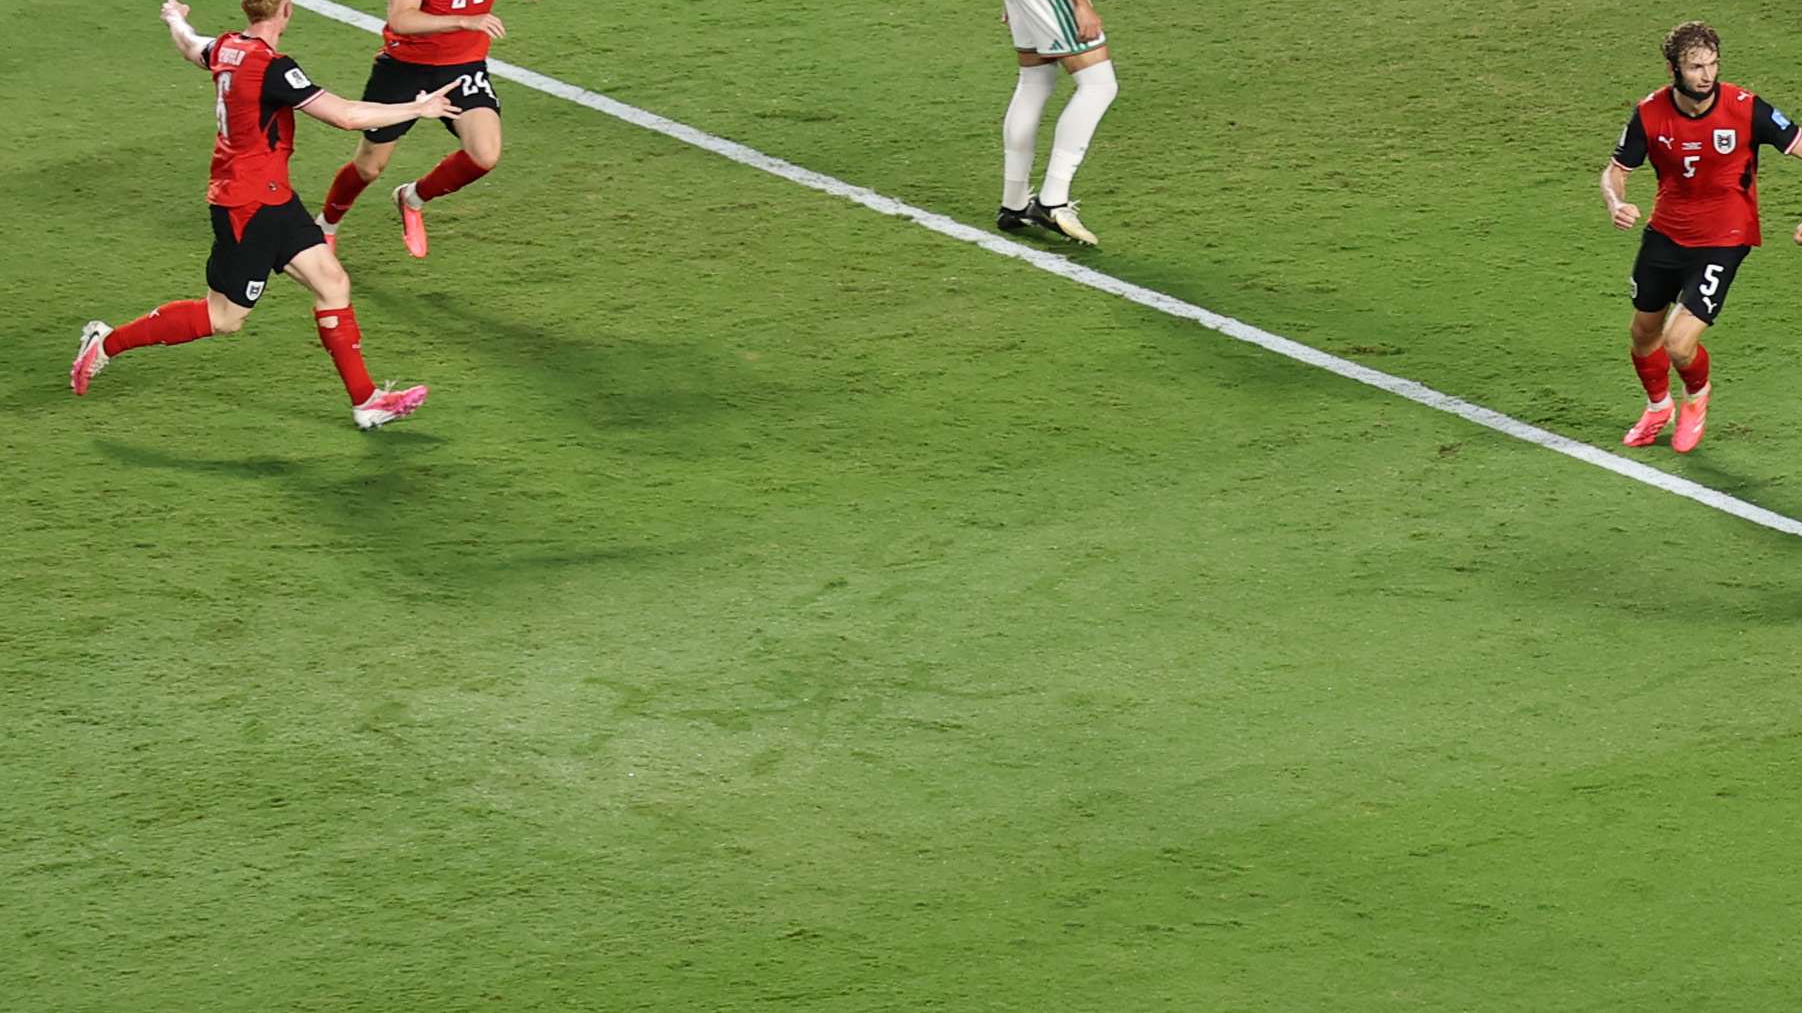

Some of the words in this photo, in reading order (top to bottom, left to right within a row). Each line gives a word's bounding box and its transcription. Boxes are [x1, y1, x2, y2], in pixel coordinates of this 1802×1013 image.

[459, 71, 496, 99] 24
[1682, 155, 1701, 178] 5
[1699, 264, 1724, 296] 5
